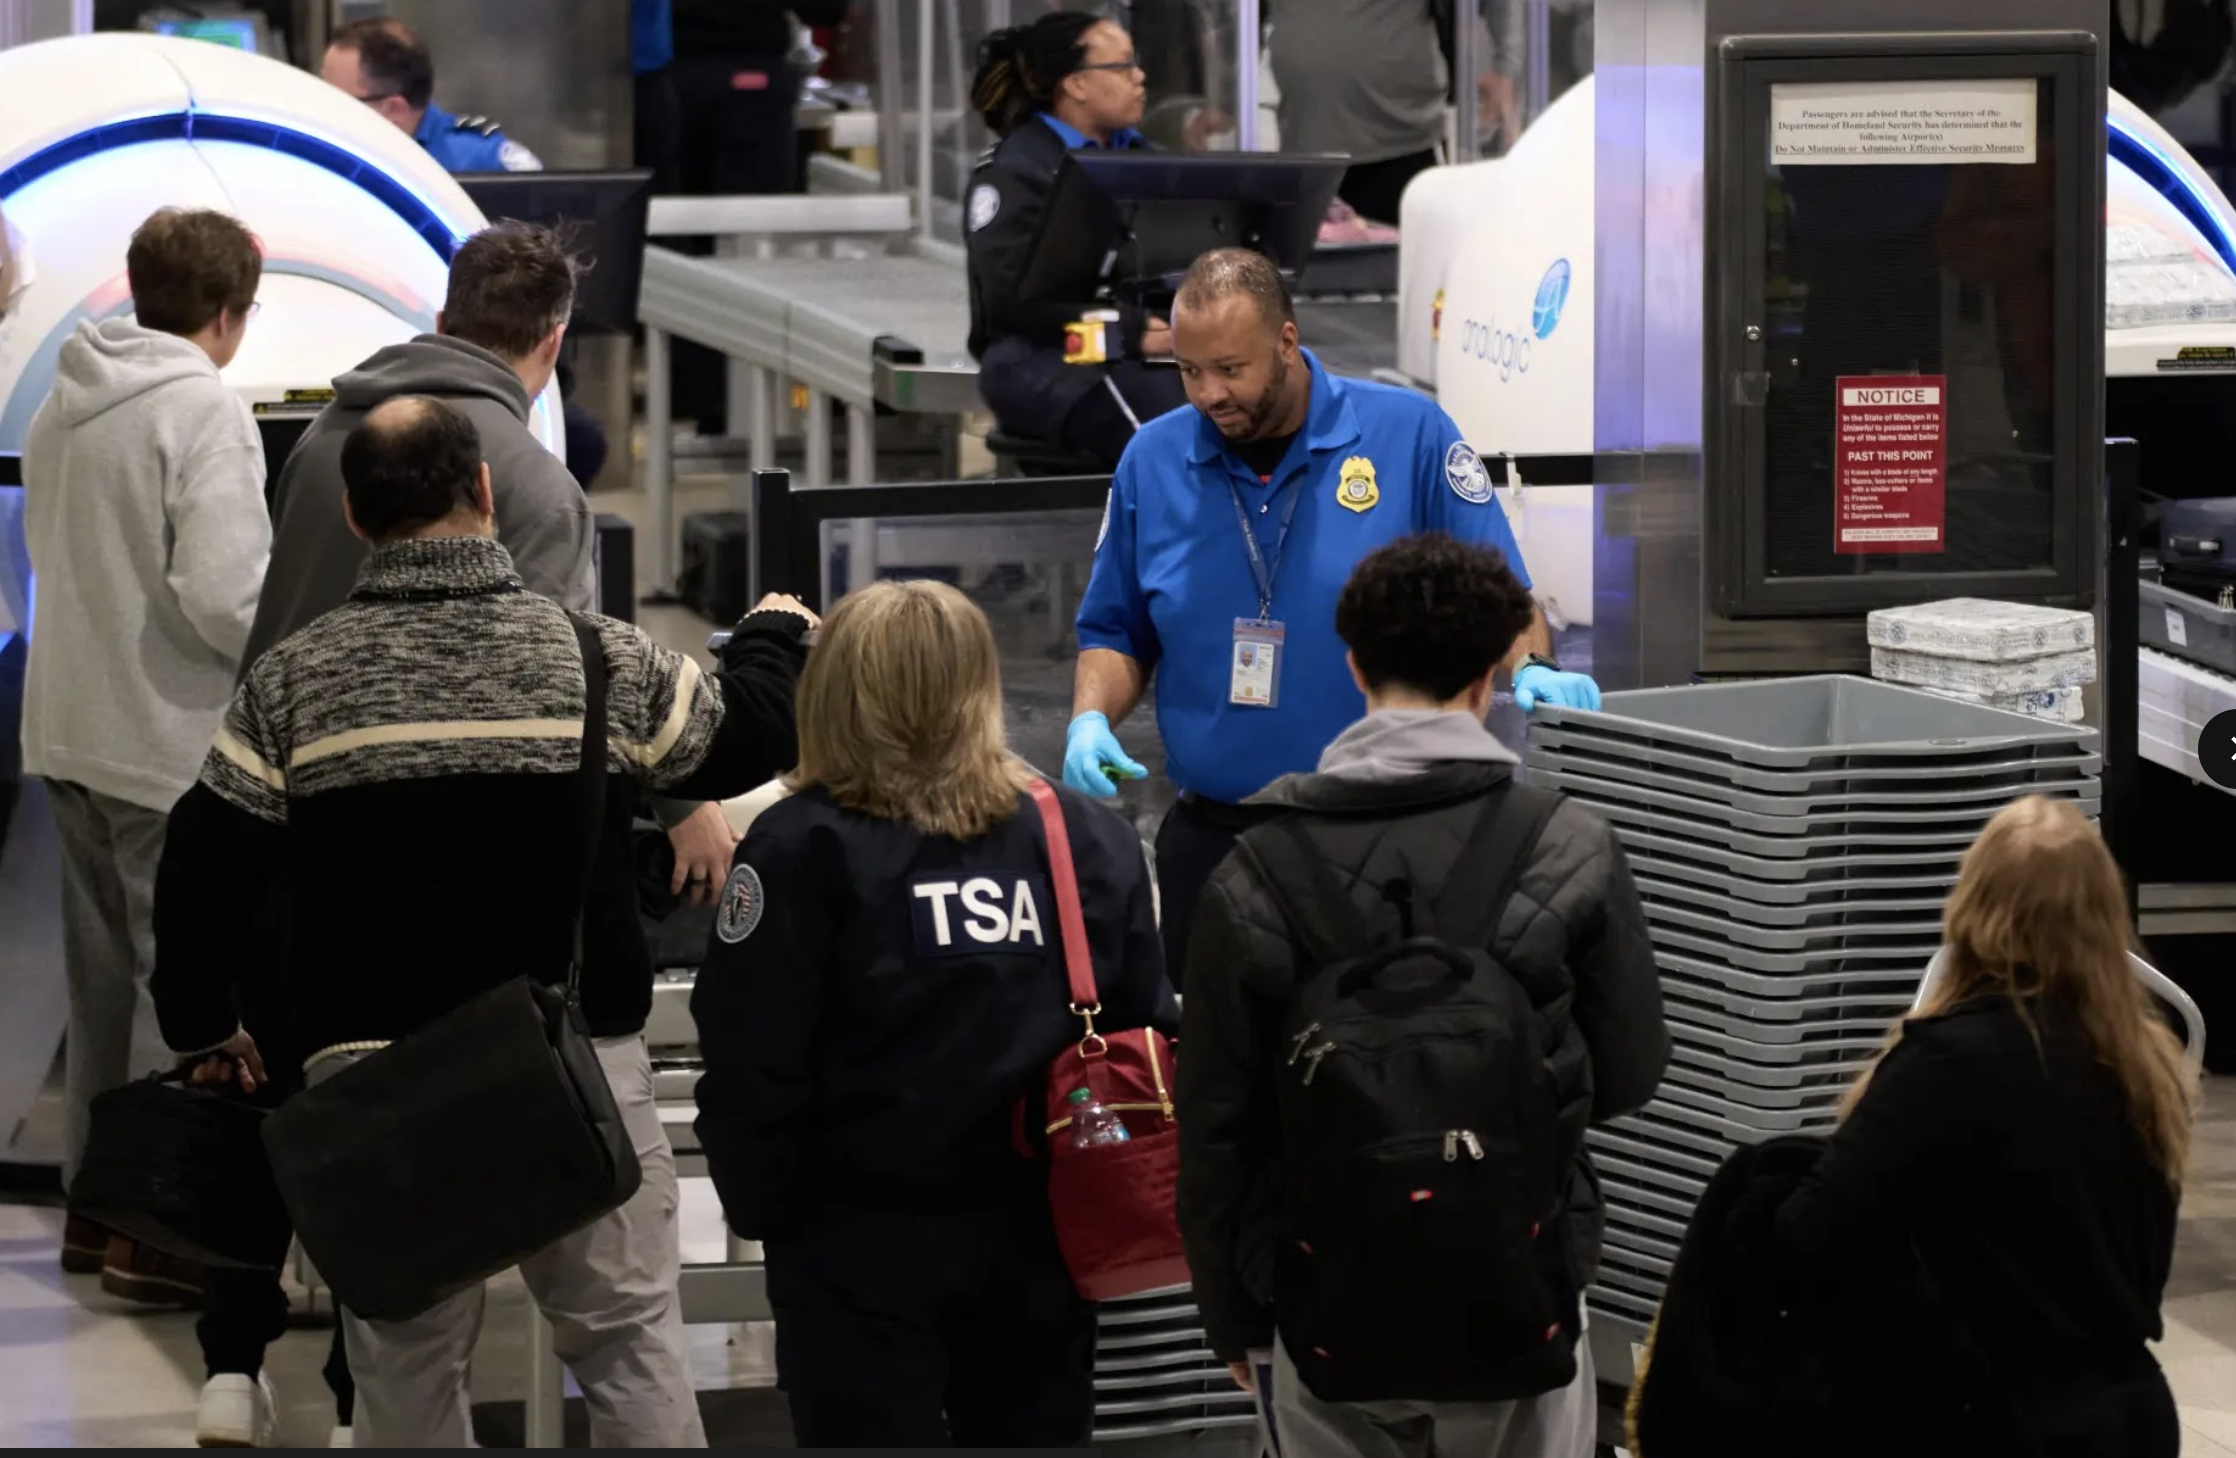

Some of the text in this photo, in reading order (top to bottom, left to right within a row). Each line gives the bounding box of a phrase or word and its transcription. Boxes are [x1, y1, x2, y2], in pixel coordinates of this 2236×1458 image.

[1802, 110, 1848, 120] Passengers
[1866, 110, 1898, 118] advised
[1900, 110, 1917, 118] that
[1919, 110, 1932, 118] the
[1934, 110, 1974, 120] Secretary
[1976, 110, 1986, 118] of
[1778, 120, 2023, 133] Department of Homeland Security has determined that the
[1859, 133, 1944, 142] following Airport(s)
[1775, 143, 2025, 154] Do Not Maintain or Administer Effective Security Measures
[1462, 313, 1531, 382] analogic
[1857, 389, 1926, 404] NOTICE
[1842, 414, 1850, 422] In
[1851, 414, 1863, 422] the
[1864, 414, 1883, 422] State
[1894, 414, 1925, 422] Michigan
[1842, 424, 1874, 432] Unlawful
[1875, 424, 1882, 432] to
[1884, 425, 1912, 433] possess
[1922, 424, 1940, 432] carry
[1842, 434, 1856, 443] any
[1856, 434, 1864, 442] of
[1866, 434, 1876, 442] the
[1878, 434, 1896, 442] items
[1848, 450, 1934, 462] PAST THIS POINT
[1870, 468, 1882, 476] with
[913, 877, 1045, 946] TSA
